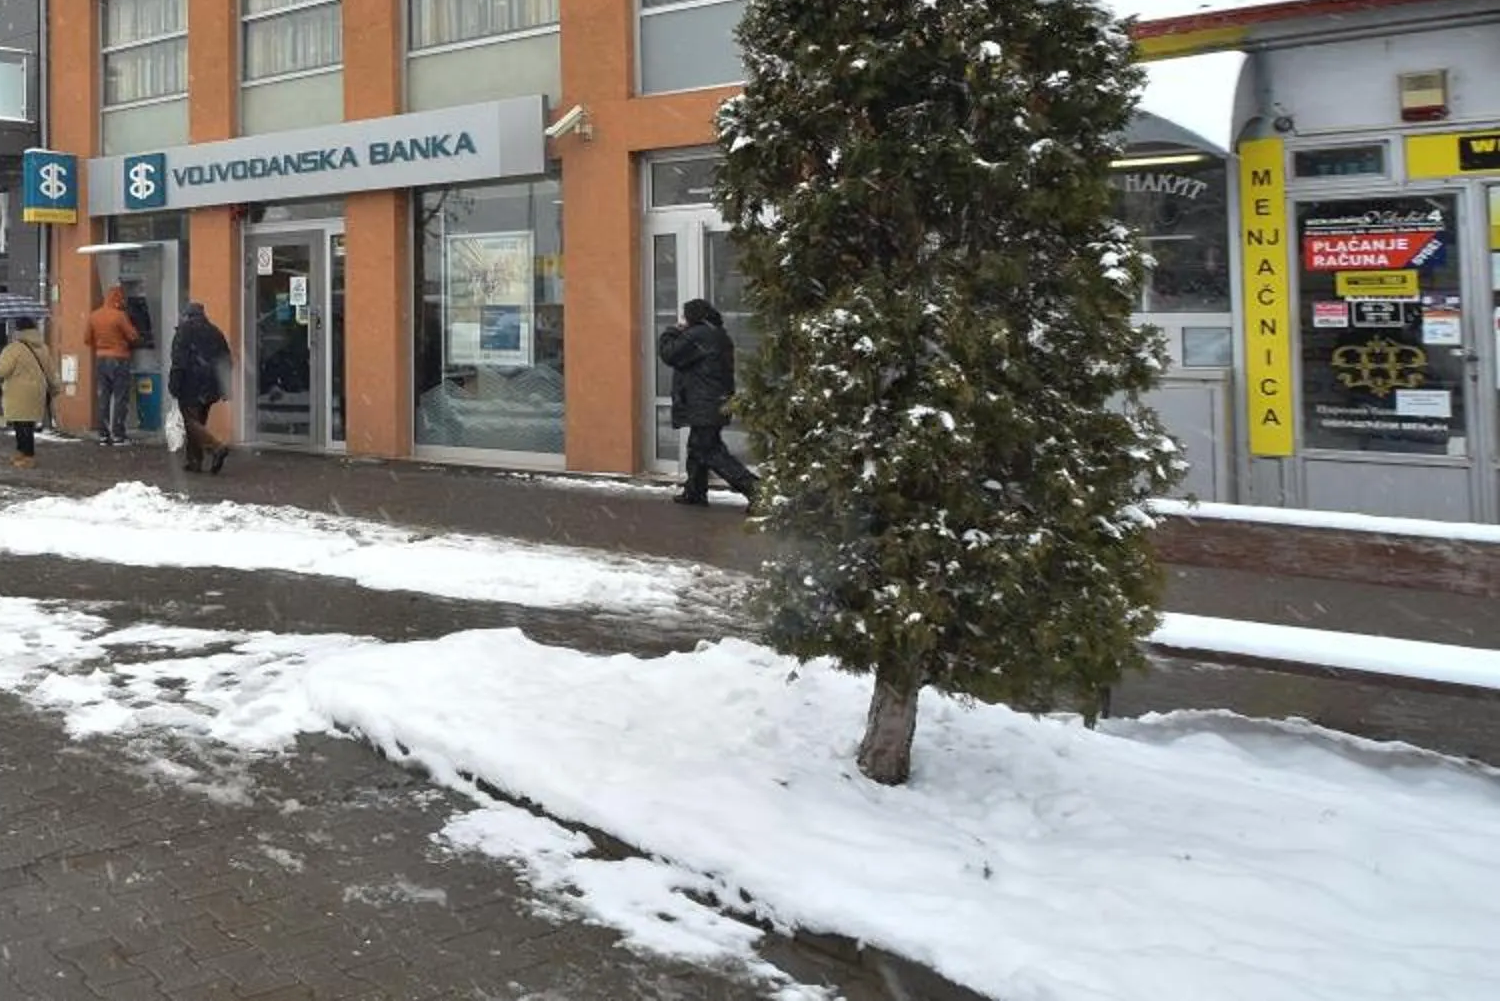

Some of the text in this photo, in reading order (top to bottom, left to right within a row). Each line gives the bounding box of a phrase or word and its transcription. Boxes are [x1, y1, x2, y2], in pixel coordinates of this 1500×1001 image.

[172, 131, 477, 188] VOJVOĐANSKA BANKA
[1311, 236, 1409, 253] PLAĆANJE
[1313, 253, 1389, 268] RAČUNA
[1247, 169, 1281, 426] MENJAČNICA
